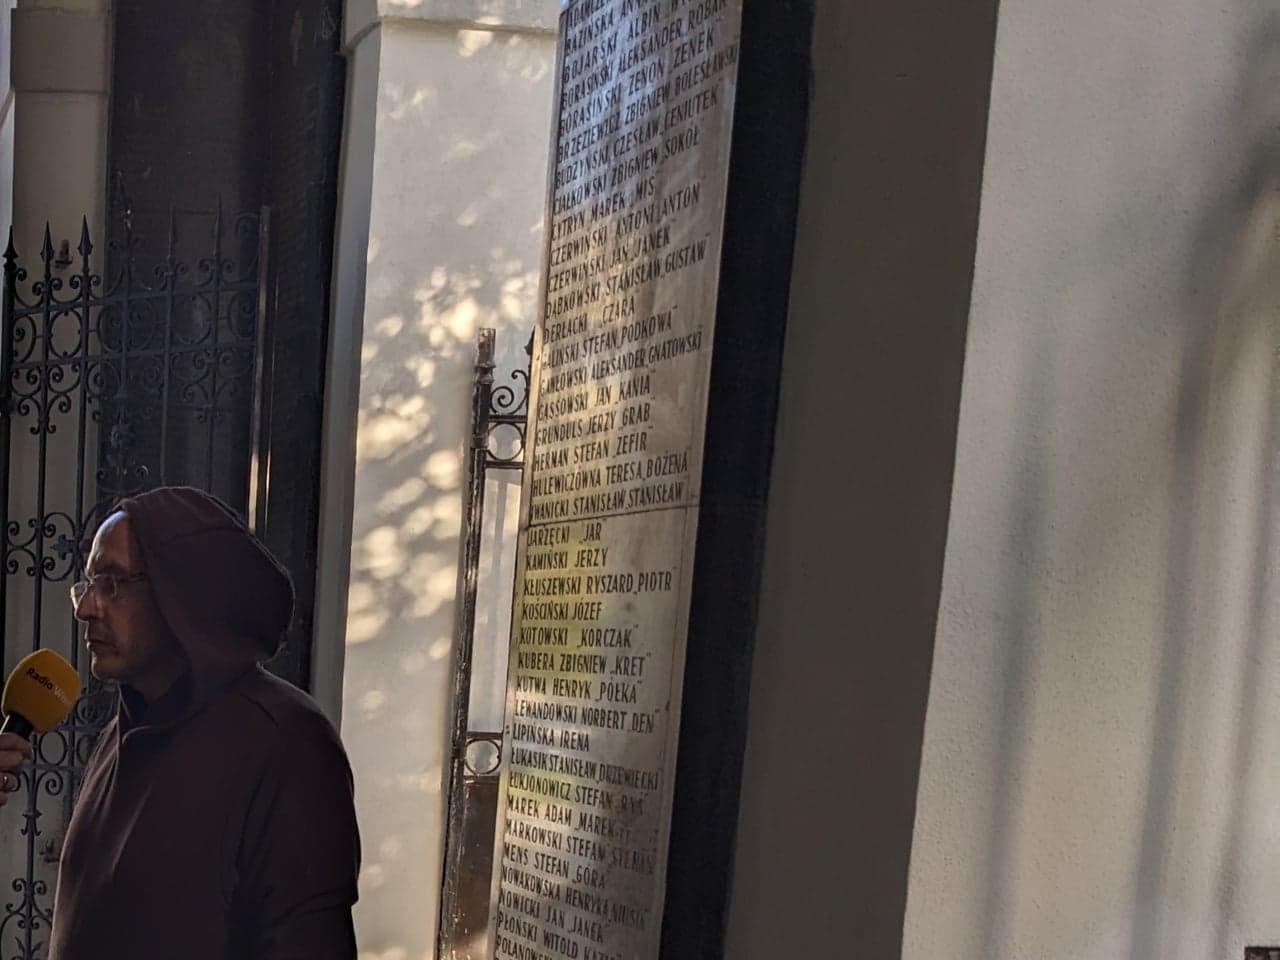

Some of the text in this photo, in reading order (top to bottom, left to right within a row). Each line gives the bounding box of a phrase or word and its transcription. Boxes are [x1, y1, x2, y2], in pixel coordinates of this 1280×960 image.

[627, 7, 660, 41] ALBIN
[611, 148, 658, 187] ZBIGNIEW
[591, 191, 625, 221] MAREK
[609, 246, 628, 269] JAN
[582, 331, 617, 358] STEFAN
[591, 355, 645, 381] ALEKSANDER
[594, 386, 611, 407] JAN
[587, 411, 616, 435] JERZY
[535, 450, 568, 472] HERMAN
[574, 440, 609, 464] STEFAN
[606, 461, 642, 486] TERESA
[573, 487, 624, 515] STANISŁAW
[526, 547, 608, 571] KAMIŃSKI JERZY
[524, 576, 581, 596] KŁUSZEWSKI
[586, 573, 633, 594] RYSZARD
[572, 596, 602, 620] JÓZEF
[520, 628, 567, 646] KOTOWSKI
[518, 652, 554, 671] KUBERA
[560, 654, 607, 674] ZBIGNIEW
[26, 667, 53, 690] Radio
[516, 676, 546, 695] KUTWA
[553, 679, 592, 701] HENRYK
[515, 699, 577, 723] LEWANDOWSKI
[582, 706, 627, 731] NORBERT
[513, 722, 590, 752] LIPIŃSKA IRENA
[549, 754, 596, 780] STANISŁAW
[508, 794, 539, 818] MAREK
[545, 804, 572, 827] ADAM
[575, 787, 612, 809] STEFAN
[505, 818, 562, 850] MARKOWSKI
[566, 835, 607, 862] STEFAN
[534, 852, 569, 879] STEFAN
[502, 864, 561, 901] NOWAKOWSKA
[499, 888, 540, 920] NOWICKI
[546, 905, 565, 929] JAN
[544, 929, 579, 959] WITOLD
